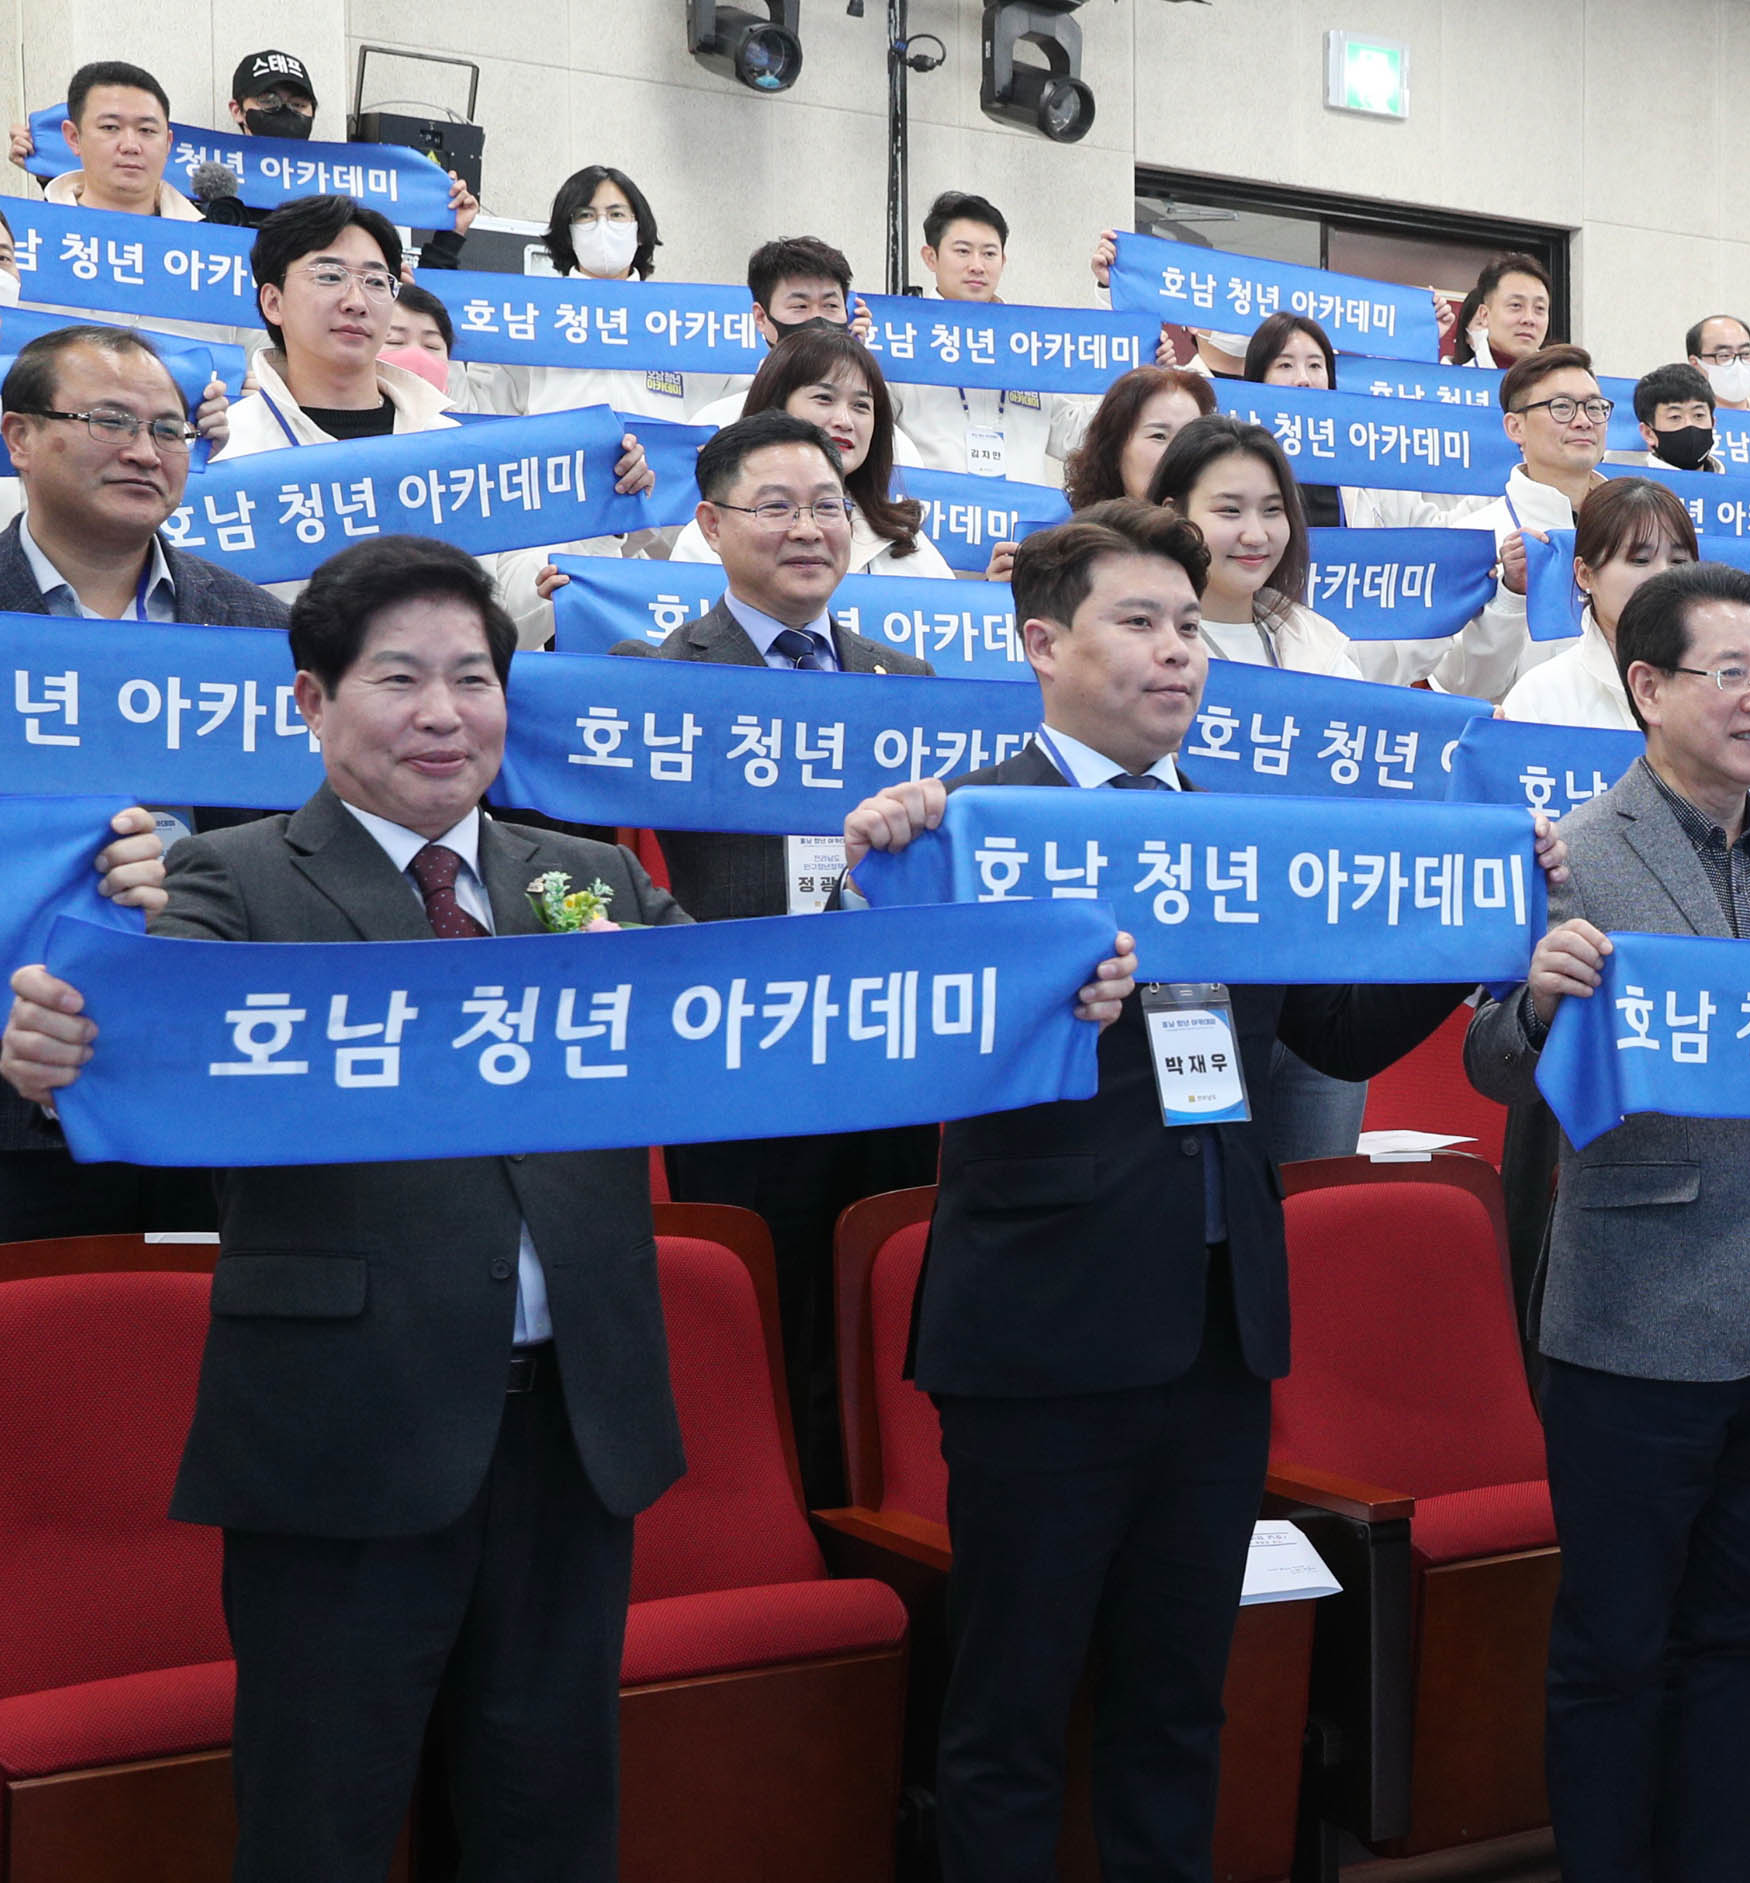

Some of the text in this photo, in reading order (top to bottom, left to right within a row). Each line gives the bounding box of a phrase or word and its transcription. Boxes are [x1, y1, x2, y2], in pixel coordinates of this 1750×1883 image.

[252, 54, 303, 79] 스태프
[261, 158, 398, 202] 아카데미
[14, 229, 258, 296] 남 청년 아카
[461, 300, 757, 349] 호남 청년 아카데
[1160, 267, 1395, 336] 호남 청년 아카데미
[864, 322, 1139, 369] 호남 청년 아카데미
[1274, 413, 1469, 468] 청년 아카데미
[162, 450, 586, 551] 호남 청년 아카데미
[896, 494, 1019, 545] 카데미
[885, 611, 1024, 661] 아카데
[15, 670, 80, 746] 년
[569, 707, 702, 781] 호남
[727, 715, 844, 788] 청년
[1188, 705, 1300, 775] 호남
[1318, 721, 1418, 789] 청년
[798, 876, 836, 893] 정광
[975, 837, 1525, 926] 호남 청년 아카데미
[210, 967, 996, 1088] 호남 청년 아카데미
[1616, 985, 1716, 1063] 호남
[1165, 1053, 1228, 1075] 박재우
